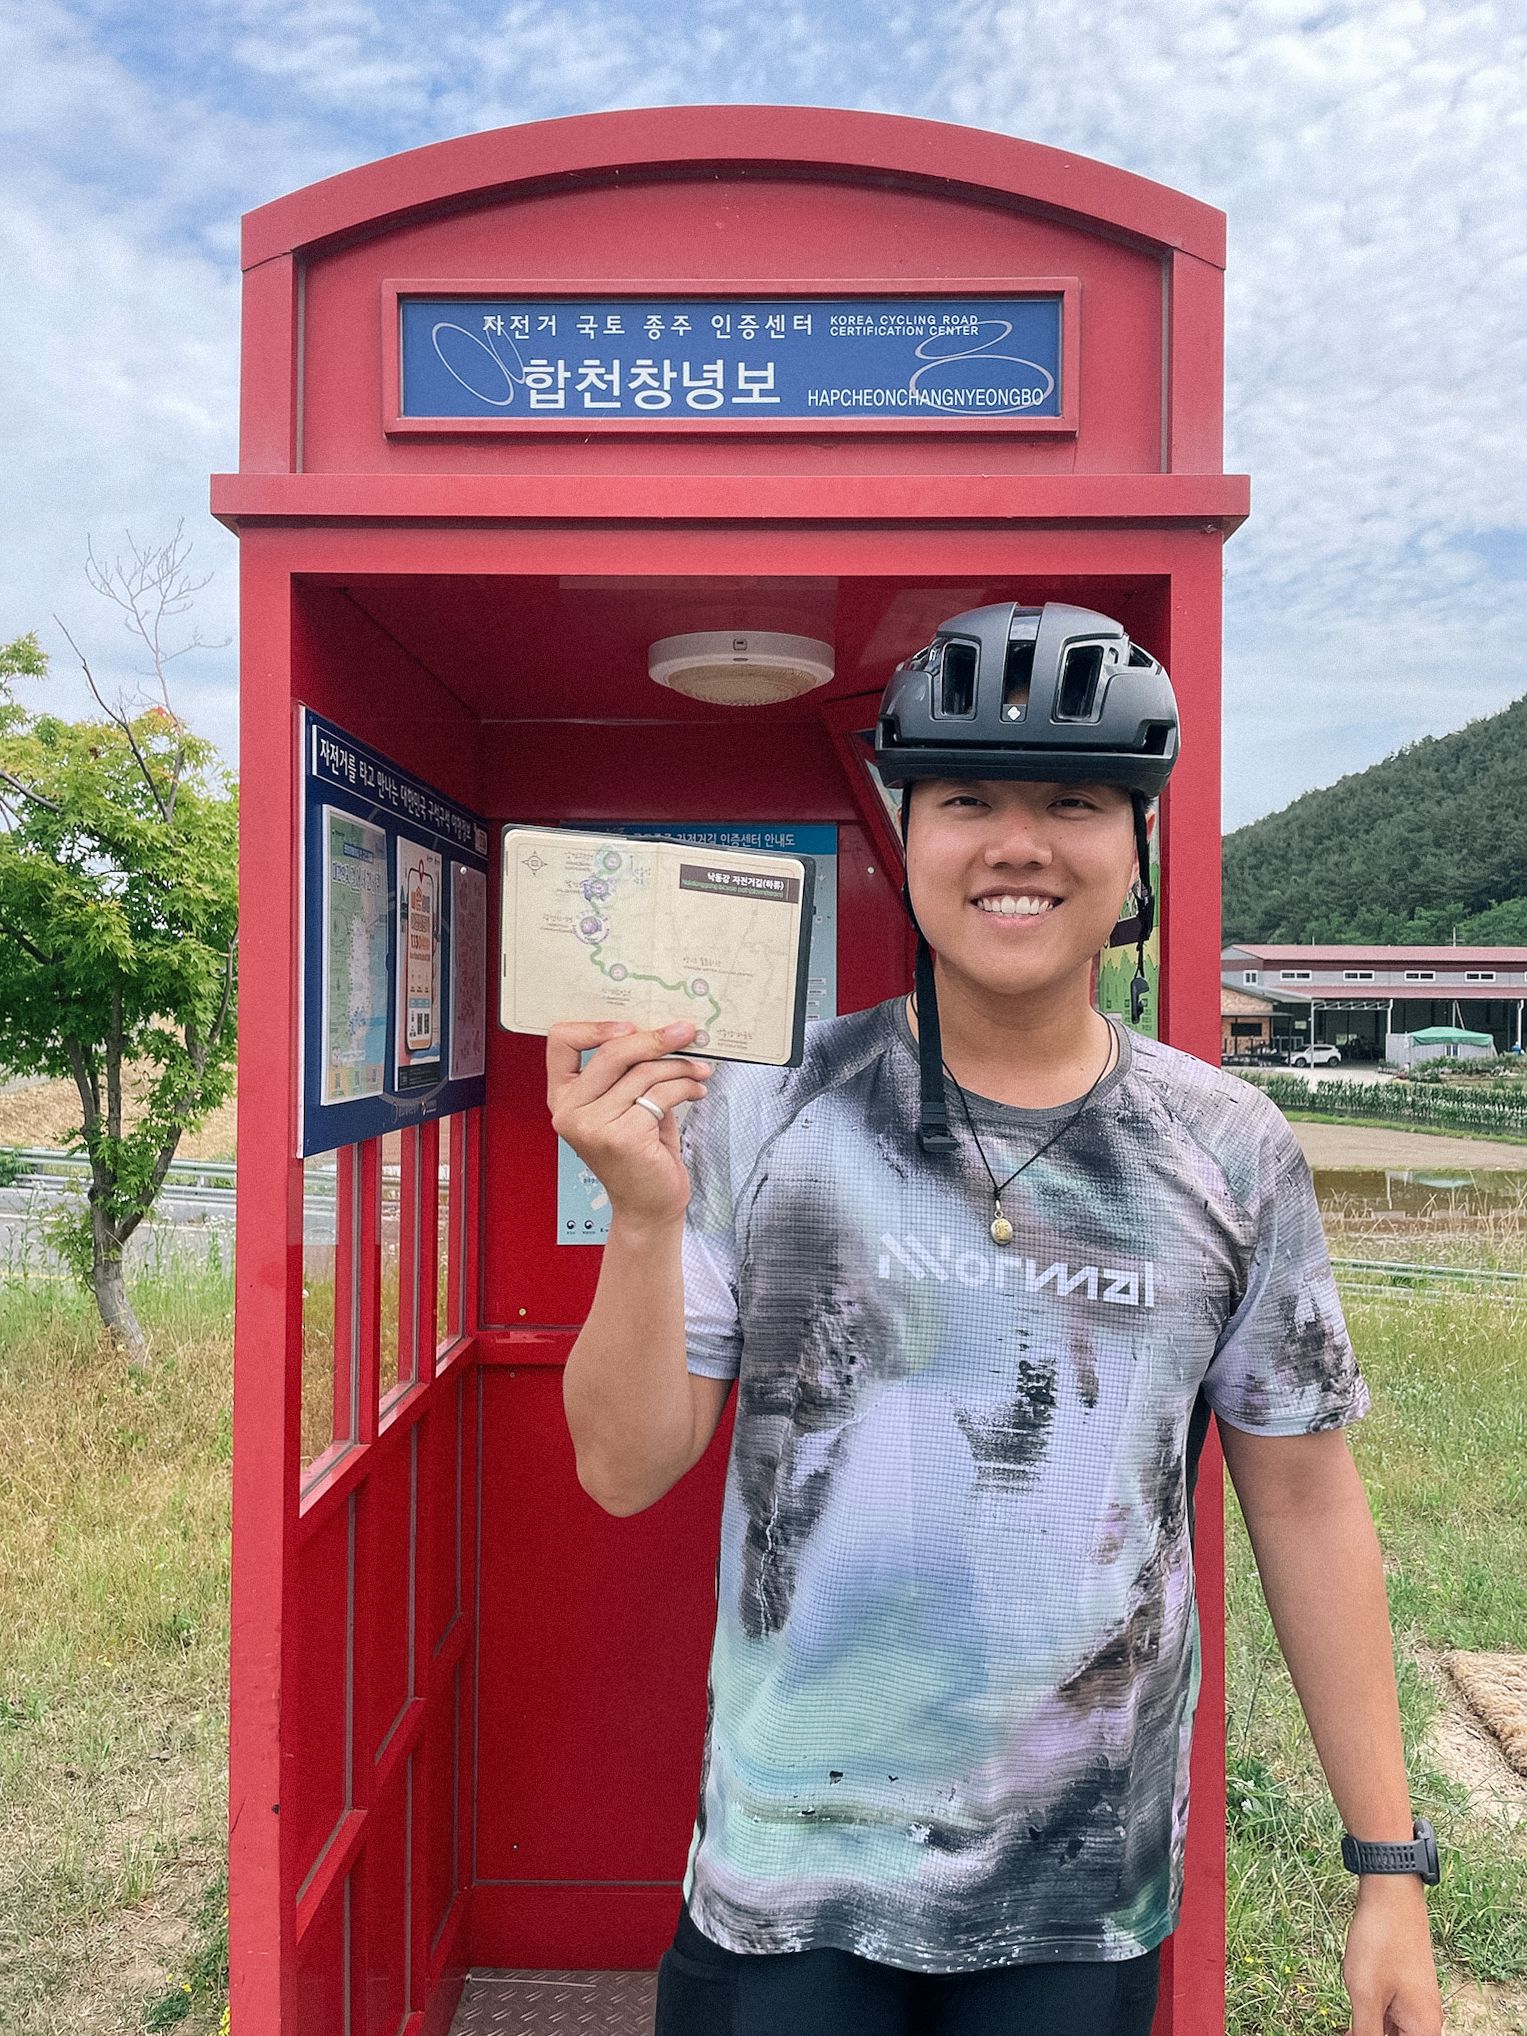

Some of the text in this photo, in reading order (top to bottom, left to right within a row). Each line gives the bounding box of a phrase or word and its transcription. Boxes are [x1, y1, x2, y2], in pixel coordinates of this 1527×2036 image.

[483, 313, 812, 340] 자전거 국토 종주 인증센터
[830, 315, 979, 326] KOREA CYCLING ROAD
[830, 325, 979, 337] CERTIFICATION CENTER
[524, 358, 781, 411] 합천창녕보
[807, 388, 1044, 407] HAPCHEONCHANGNYEONGBO
[320, 738, 357, 784] 자전거를
[359, 760, 376, 788] 타고
[377, 771, 399, 806] 만나는
[720, 833, 762, 848] 인증센터
[764, 833, 796, 848] 안내도
[706, 871, 731, 884] 낙동강
